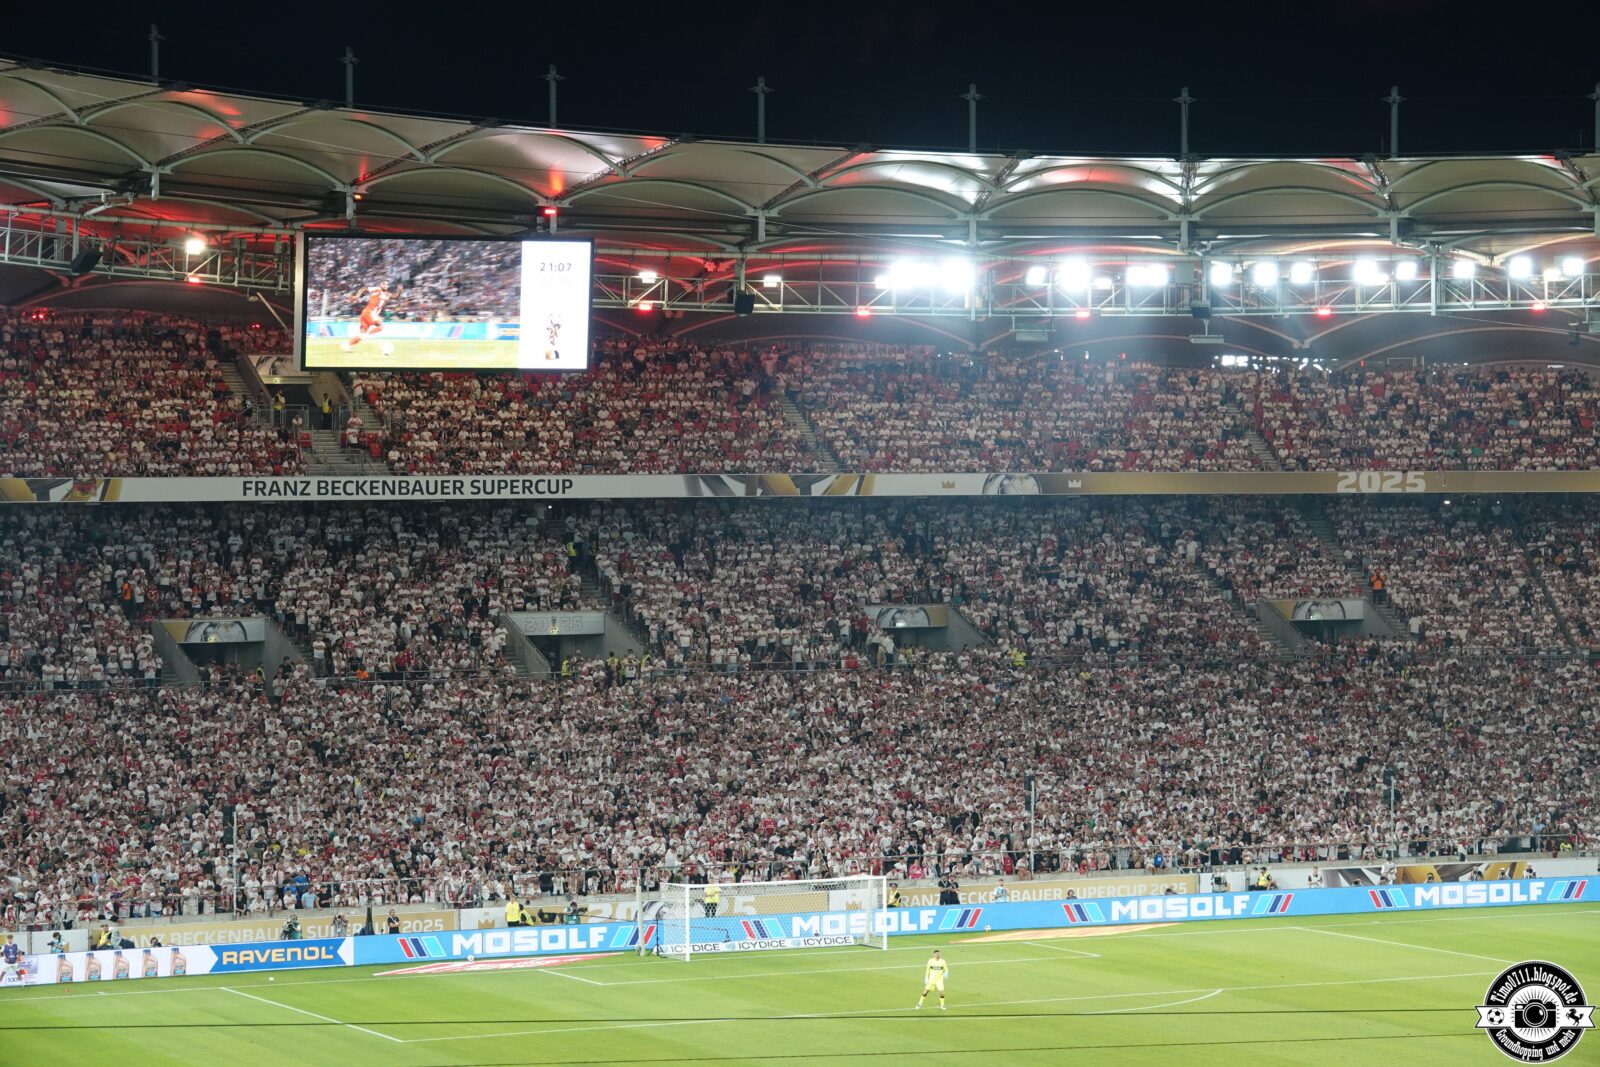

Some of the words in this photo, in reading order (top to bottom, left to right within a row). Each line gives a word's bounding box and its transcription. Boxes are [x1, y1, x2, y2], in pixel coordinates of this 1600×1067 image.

[540, 262, 572, 272] 21:07
[242, 480, 311, 496] FRANZ
[316, 479, 465, 495] BECKENBAUER
[470, 479, 573, 495] SUPERCUP
[1336, 471, 1426, 493] 2025
[899, 892, 941, 907] RANZ
[1414, 881, 1545, 907] MOSOLF
[1111, 894, 1250, 921] MOSOLF
[170, 927, 281, 945] BECKENBAU
[402, 918, 444, 934] 2025
[792, 909, 937, 938] MOSOLF
[452, 926, 608, 956] MOSOLF
[738, 939, 785, 950] ICYDICE
[803, 936, 852, 946] ICYDICE
